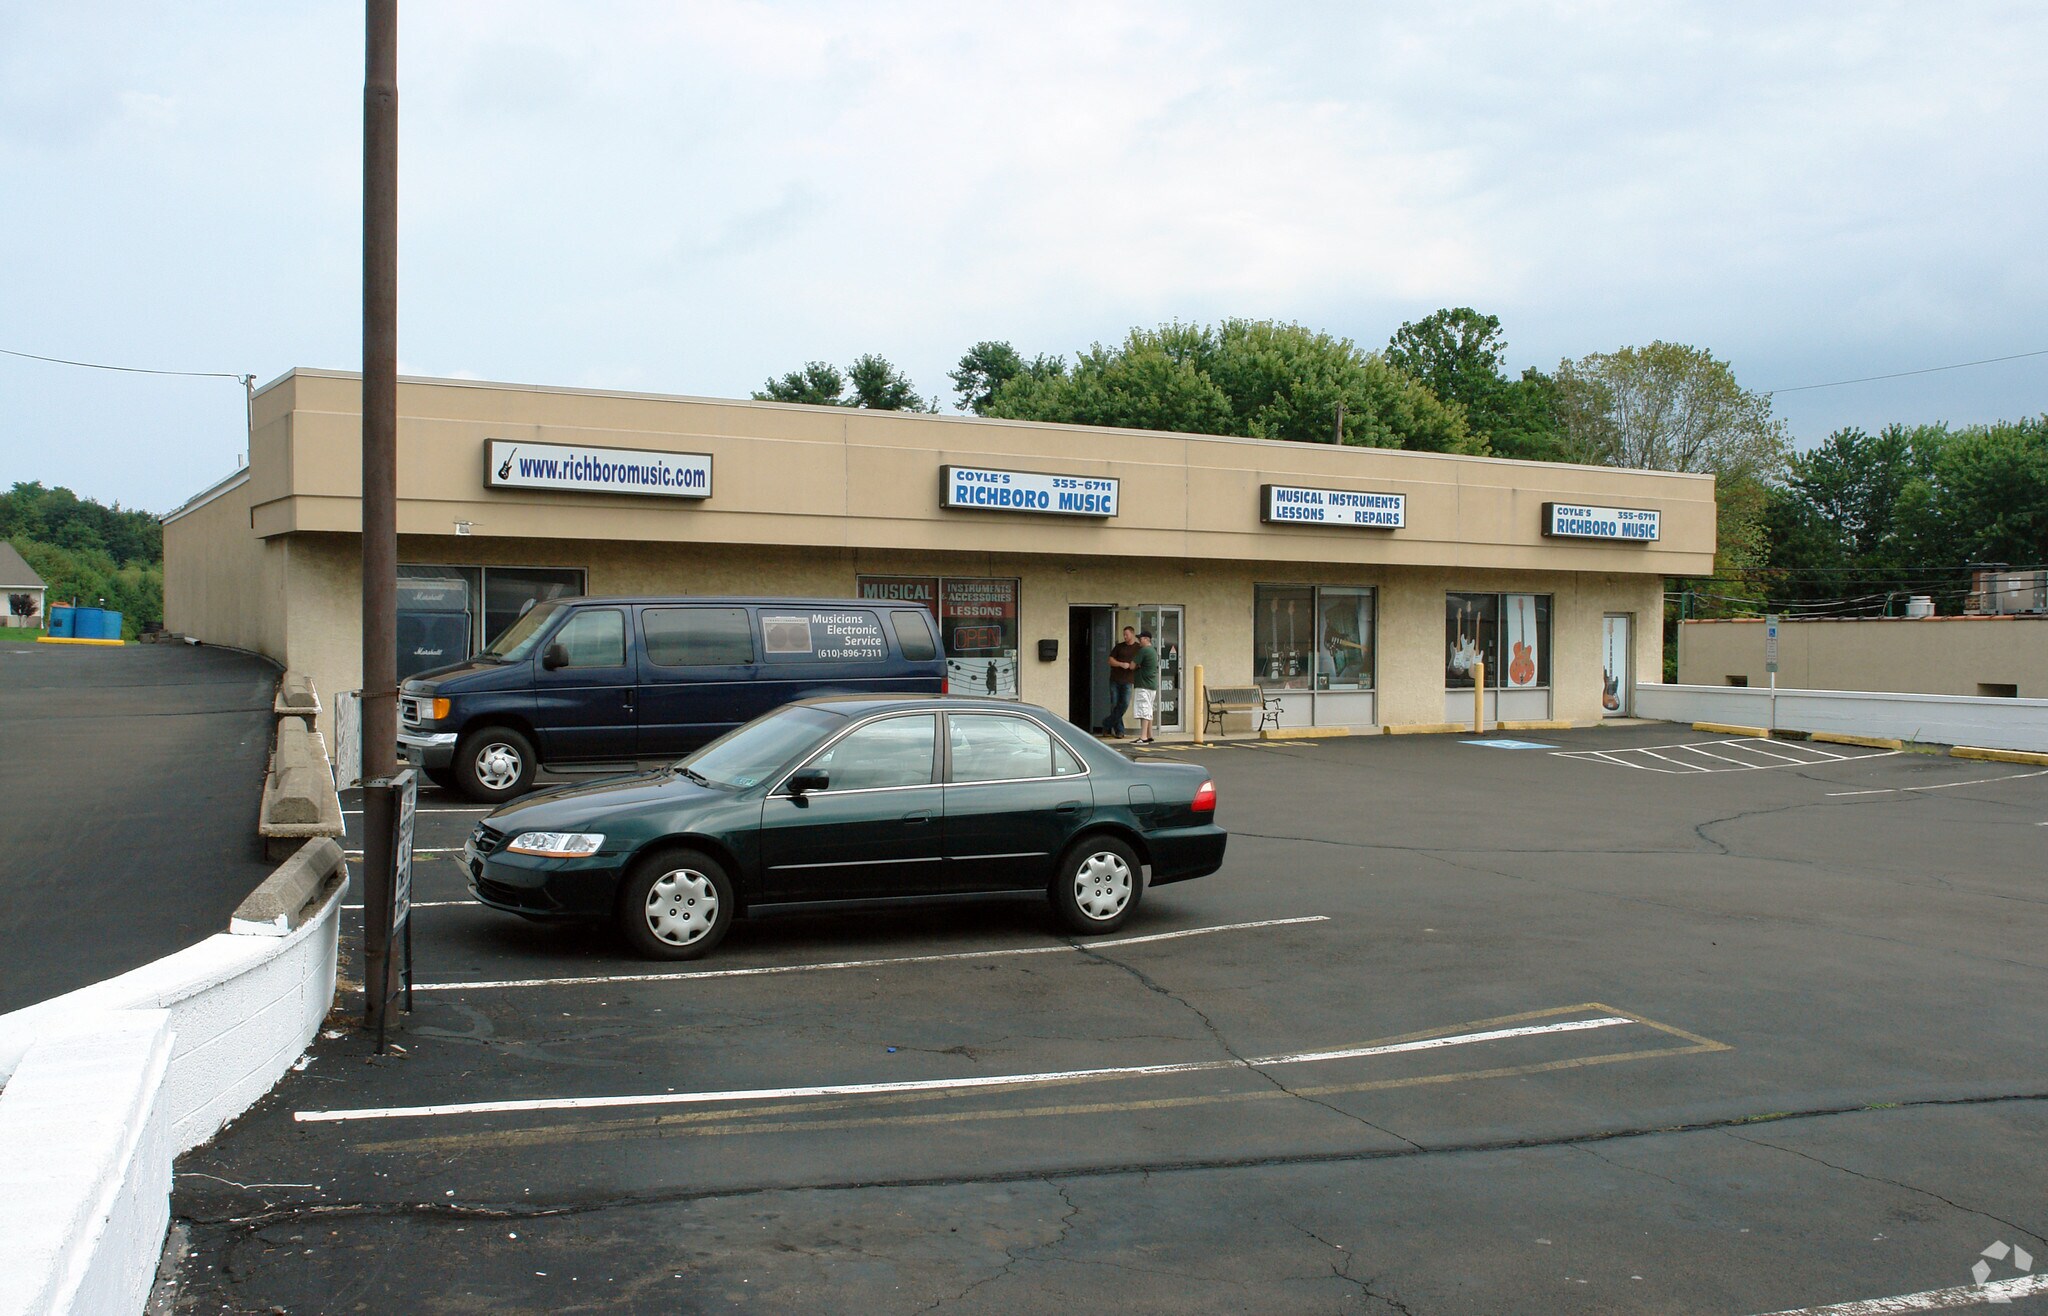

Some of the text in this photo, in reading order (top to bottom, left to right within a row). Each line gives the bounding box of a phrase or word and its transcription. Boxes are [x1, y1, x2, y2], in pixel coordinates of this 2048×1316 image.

[520, 454, 705, 487] www.richboromusic.com
[956, 471, 1112, 491] COYLE'S 355-6711
[956, 485, 1111, 513] RICHBORO MUSIC
[1276, 489, 1400, 509] MUSICAL INSTRUMENTS
[1276, 506, 1400, 524] LESSONS REPAIRS
[1557, 507, 1656, 521] COYLE'S 355-6711
[1556, 518, 1656, 538] RICHBORO MUSIC
[863, 583, 933, 599] MUSICAL
[947, 583, 1012, 593] INSTRUMENTS
[948, 592, 1012, 602] ACCESSORIES
[950, 606, 1003, 616] LESSONS
[812, 614, 863, 624] Musicians
[827, 624, 877, 635] Electronic
[845, 636, 882, 646] Service
[956, 627, 999, 648] OPEN
[414, 647, 443, 656] Marshall
[818, 648, 882, 658] (610)-896-7311
